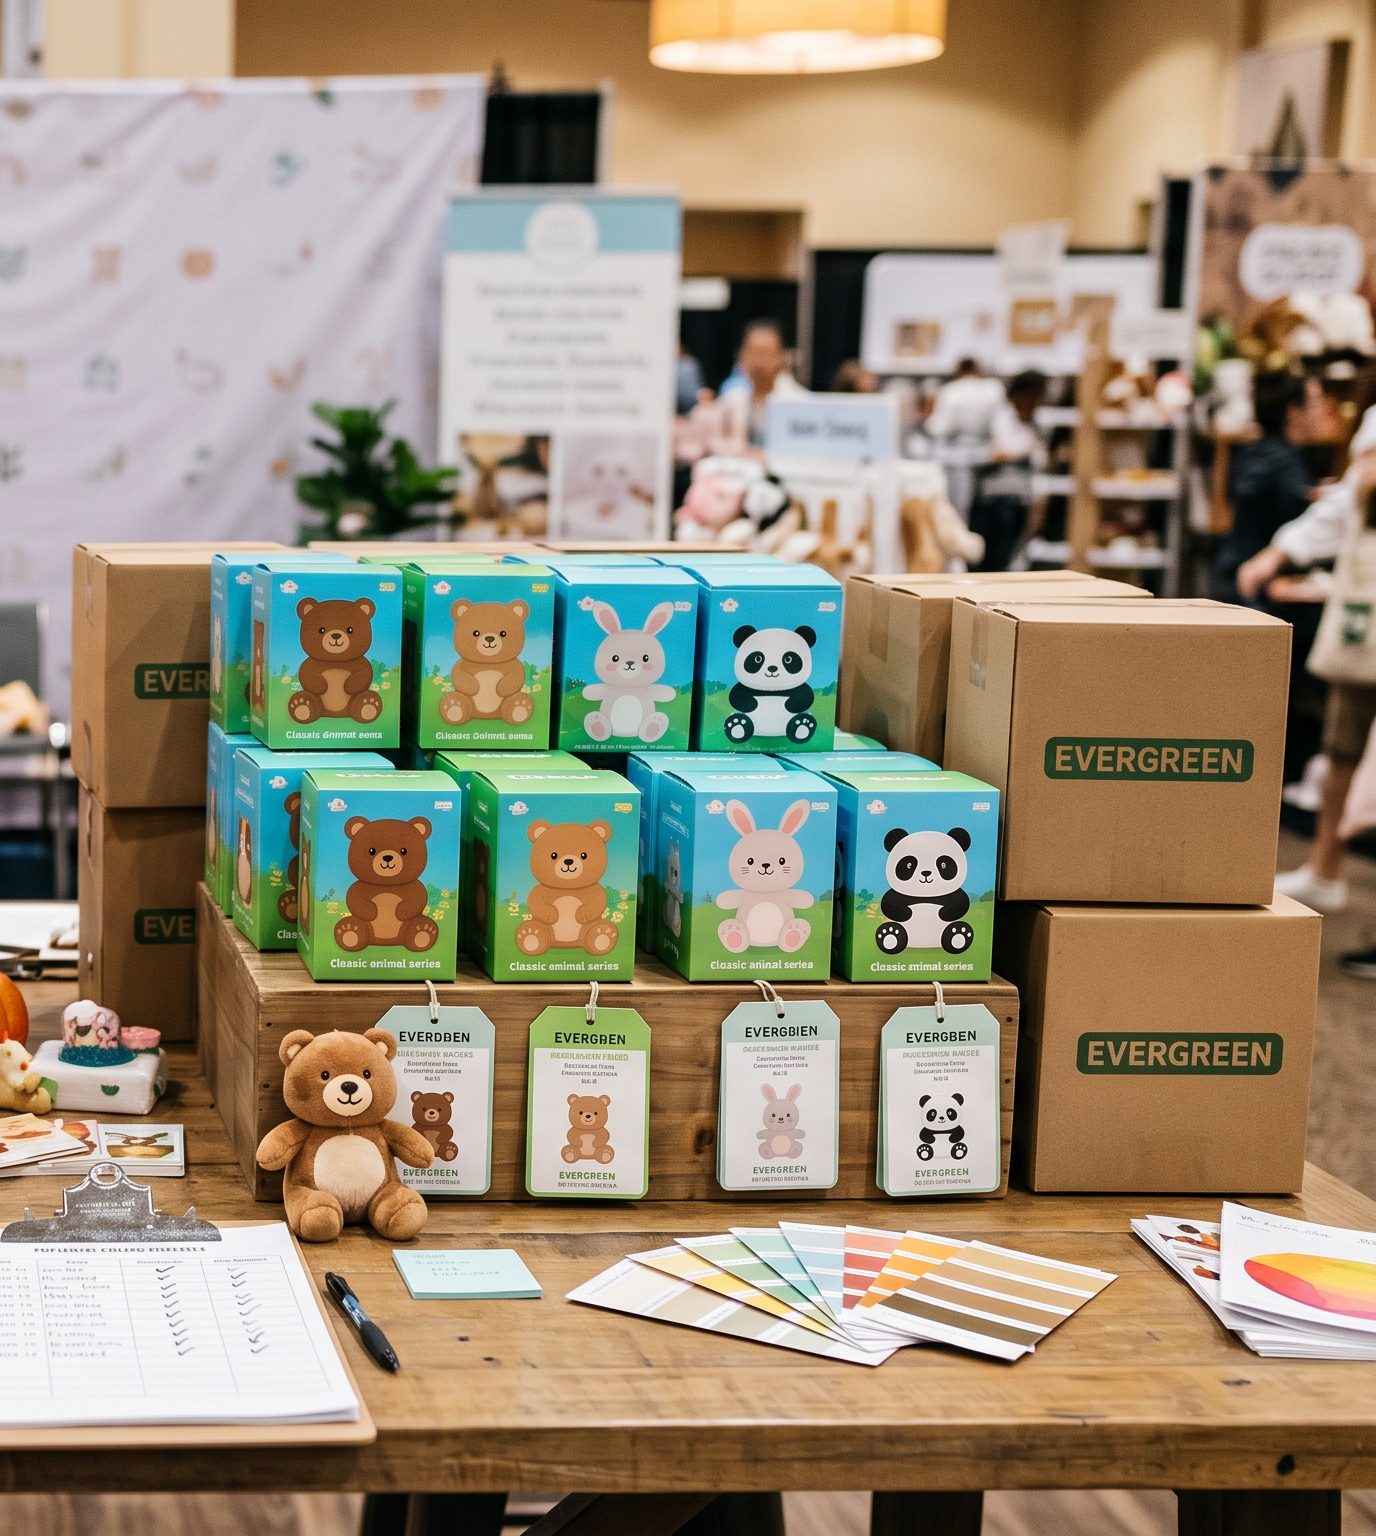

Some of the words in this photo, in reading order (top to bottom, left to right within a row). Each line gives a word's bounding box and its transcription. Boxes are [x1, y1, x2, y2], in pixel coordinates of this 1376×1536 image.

[1055, 745, 1243, 774] EVERGREEN
[409, 958, 441, 968] series
[943, 961, 974, 971] series
[1087, 1040, 1272, 1067] EVERGREEN
[753, 1165, 807, 1174] EVERGREEN
[915, 1168, 969, 1177] EVERGREEN
